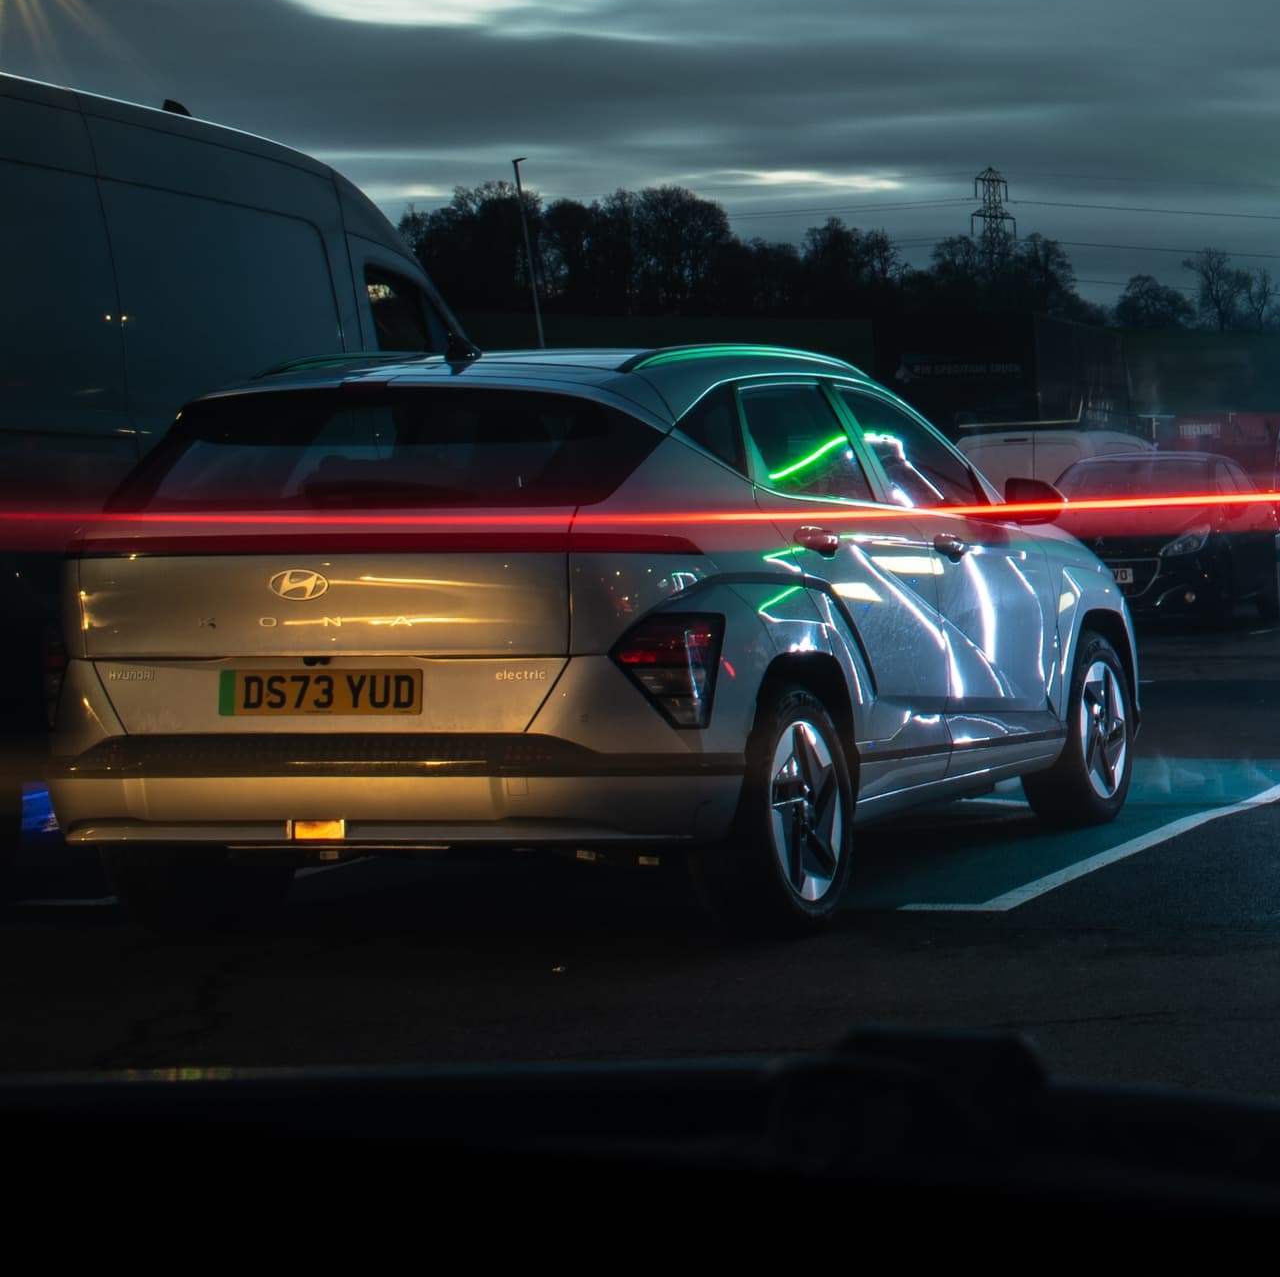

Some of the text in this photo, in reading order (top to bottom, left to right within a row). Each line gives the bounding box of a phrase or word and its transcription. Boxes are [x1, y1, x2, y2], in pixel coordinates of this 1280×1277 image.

[1112, 569, 1128, 581] VO
[199, 616, 413, 627] KONA
[495, 669, 546, 681] electric
[243, 675, 415, 709] DS73 YUD
